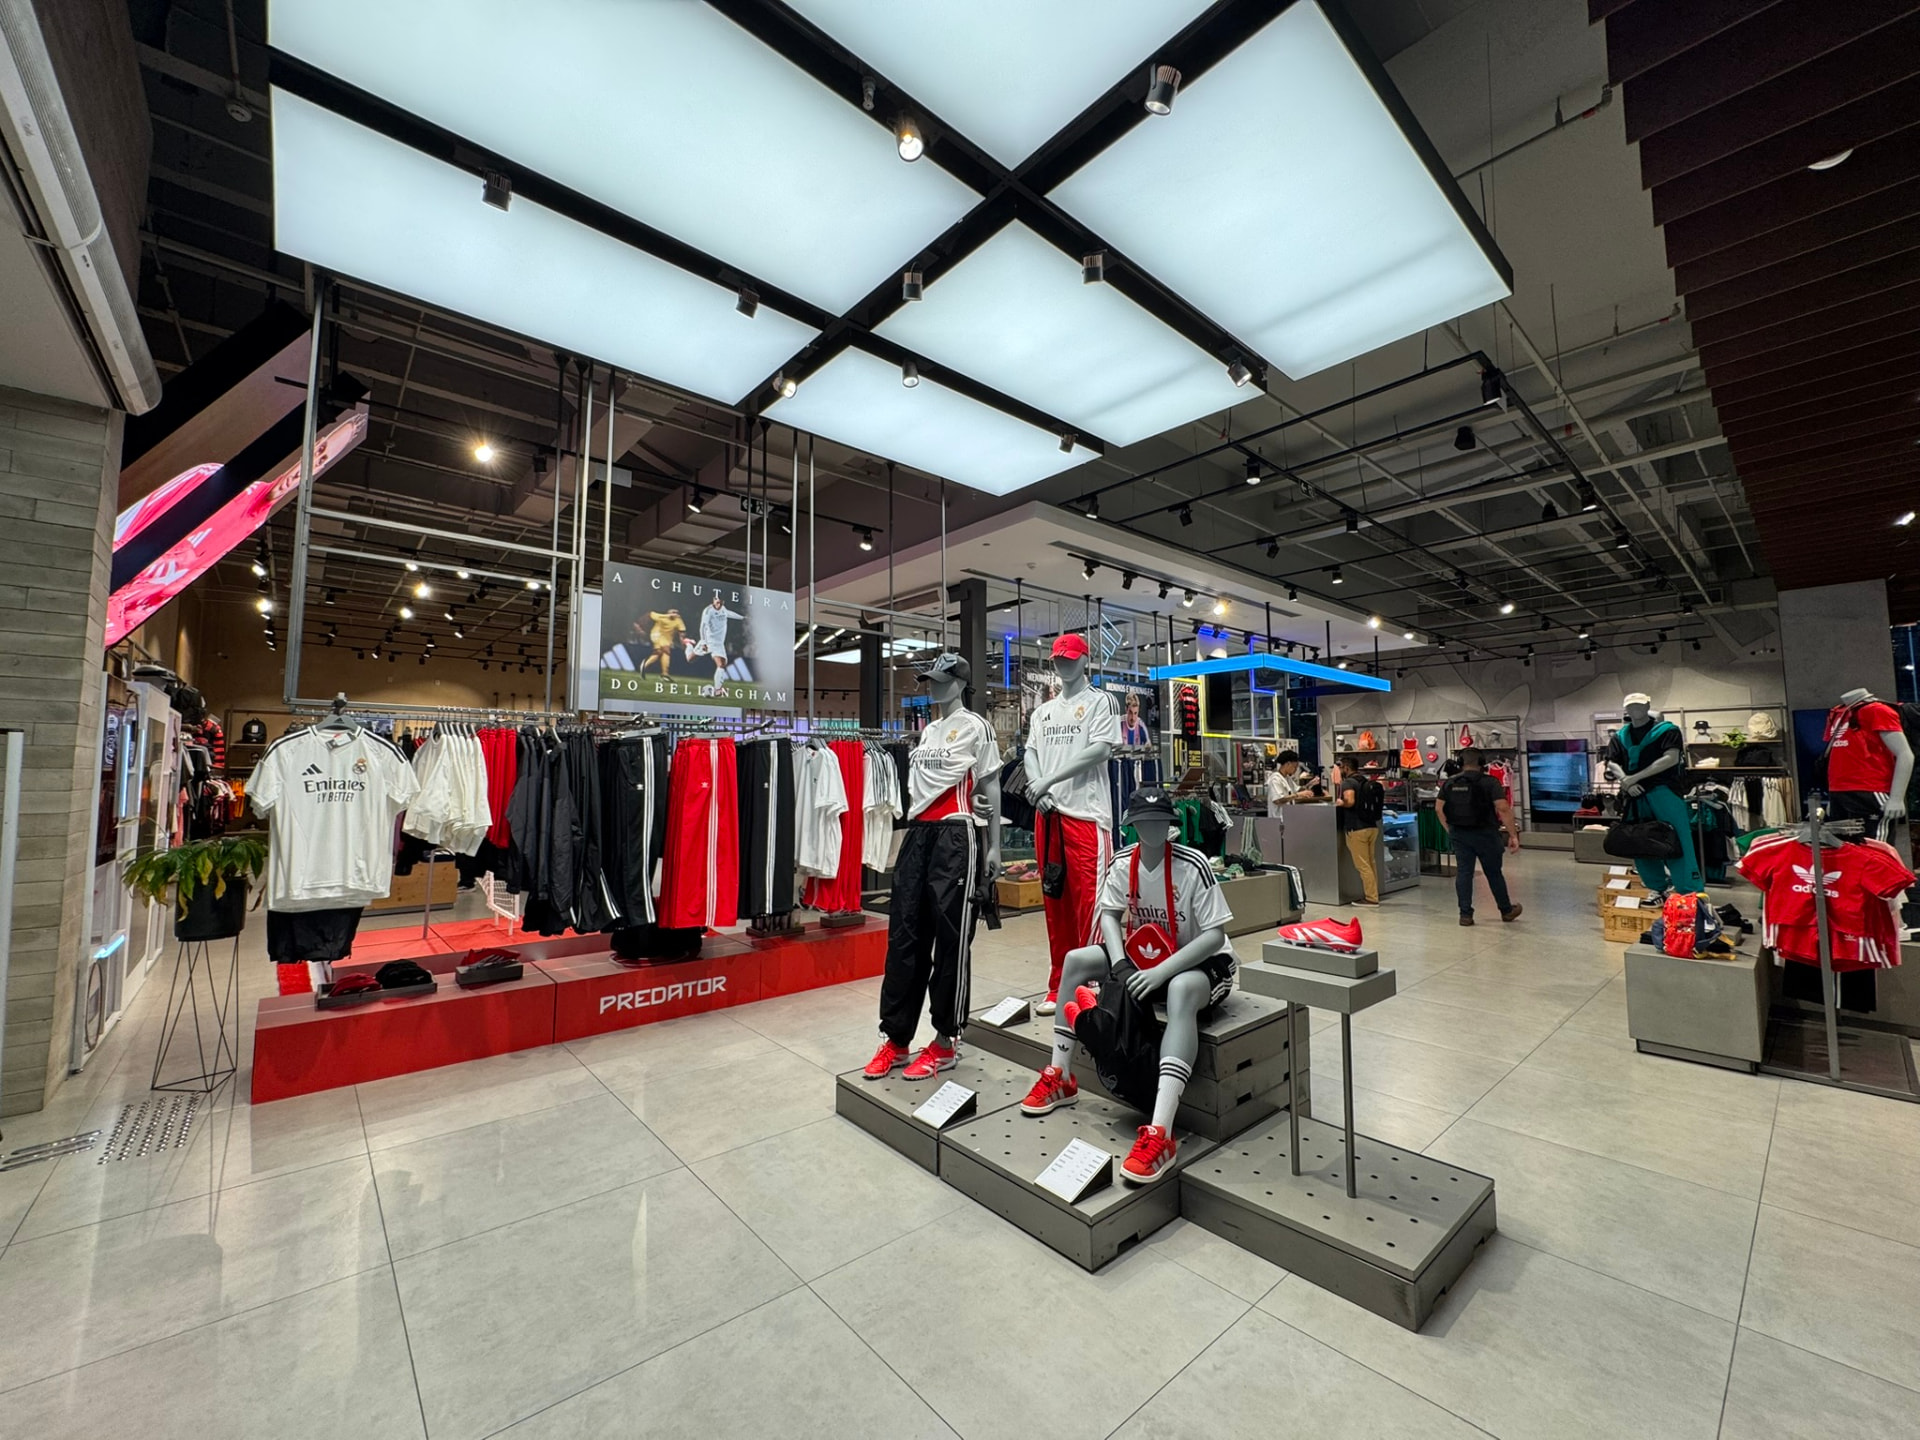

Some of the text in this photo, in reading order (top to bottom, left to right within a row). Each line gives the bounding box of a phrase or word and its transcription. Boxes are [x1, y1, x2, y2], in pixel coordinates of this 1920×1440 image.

[612, 572, 789, 611] A CHUTEIRA
[611, 678, 787, 702] DO BELLINGHAM
[1128, 904, 1187, 922] Emiraes
[600, 976, 727, 1015] PREDATOR
